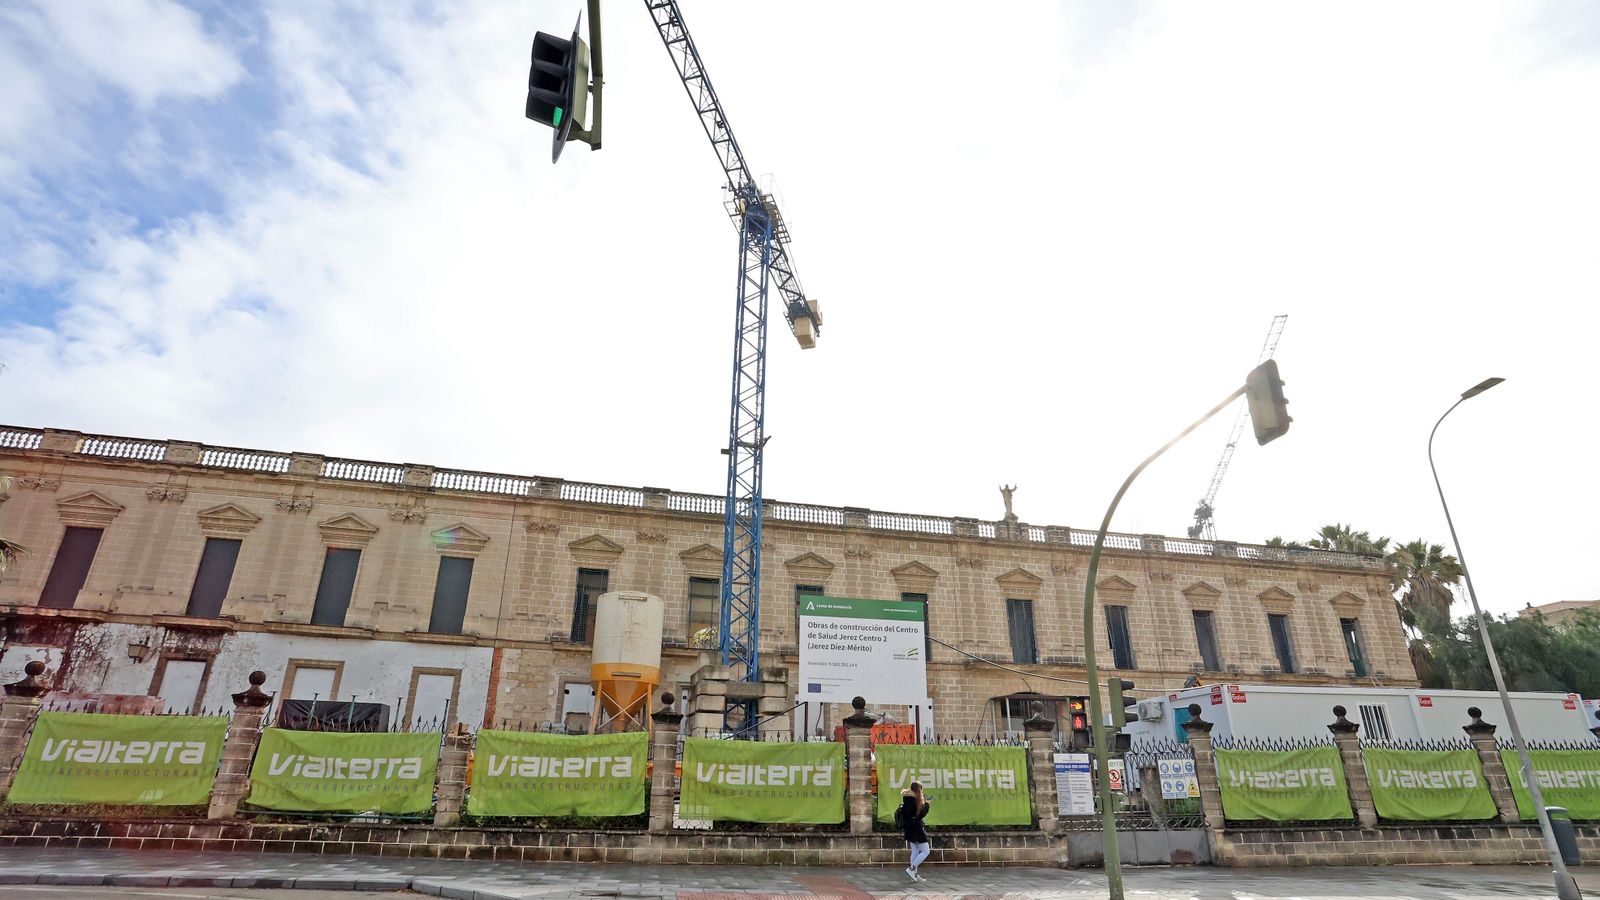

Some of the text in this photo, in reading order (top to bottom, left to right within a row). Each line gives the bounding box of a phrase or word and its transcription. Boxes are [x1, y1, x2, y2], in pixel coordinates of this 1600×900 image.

[807, 621, 828, 629] Obras
[829, 622, 838, 630] de
[839, 623, 883, 632] construcción
[896, 626, 919, 634] Centro
[818, 632, 838, 640] Salud
[839, 633, 858, 641] Jerez
[859, 634, 882, 642] Centro
[807, 641, 829, 651] (Jerez
[40, 738, 206, 764] Vialterra
[51, 767, 199, 779] INFRAESTRUCTURAS
[268, 753, 422, 780] Vialterra
[487, 755, 633, 778] Vialterra
[696, 762, 832, 786] Vialterra
[500, 781, 631, 791] INFRAESTRUCTURAS
[1229, 767, 1336, 788] Vialterra
[1377, 768, 1477, 788] Vialterra
